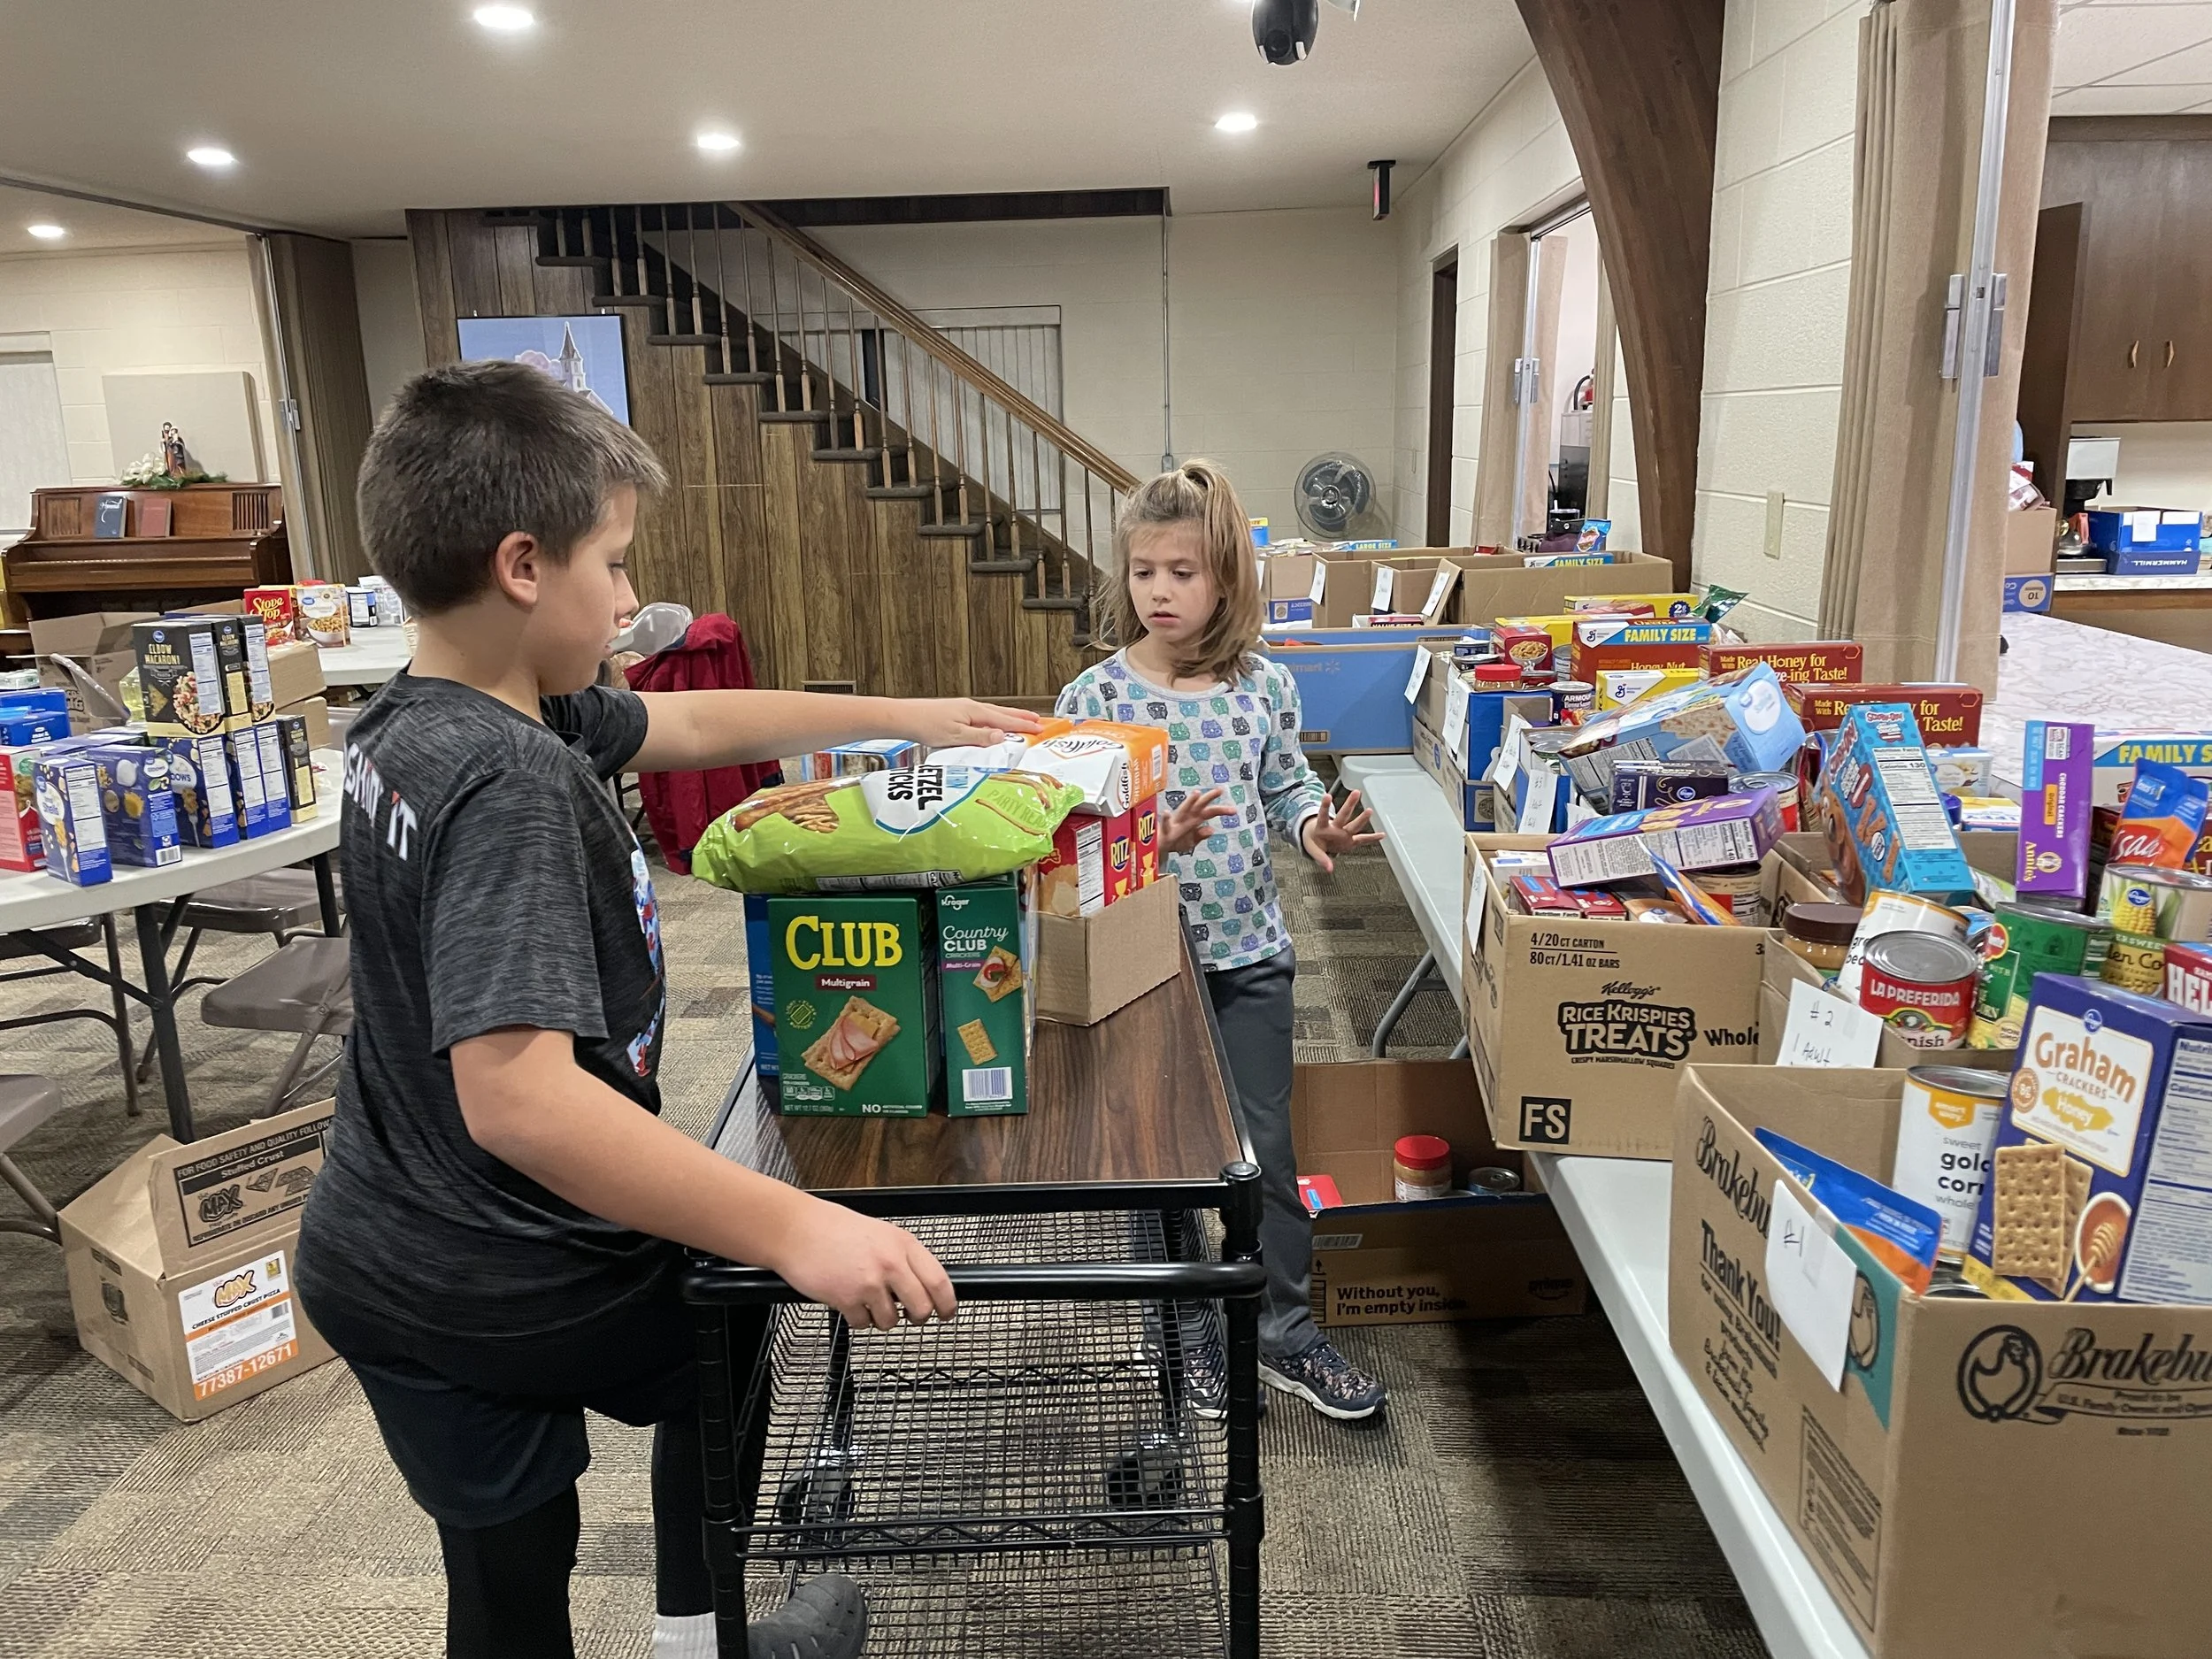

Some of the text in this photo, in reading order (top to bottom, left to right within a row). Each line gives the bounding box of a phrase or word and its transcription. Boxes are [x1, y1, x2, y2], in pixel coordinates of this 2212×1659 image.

[1555, 557, 1604, 567] FAMILY SIZE
[252, 596, 284, 611] Stove
[262, 607, 281, 621] Top
[1624, 627, 1697, 642] FAMILY SIZE
[148, 643, 173, 655] ELBOW
[144, 655, 180, 665] MACARONI
[1667, 661, 1686, 670] Nut
[1720, 652, 1826, 671] Made Real Honey for
[1775, 667, 1847, 683] ze-ing Taste!
[1815, 699, 1832, 708] Made
[1920, 698, 1940, 716] for
[1815, 707, 1832, 716] With
[1924, 717, 1963, 733] Taste!
[1042, 736, 1125, 755] Goldfish
[2118, 744, 2198, 764] FAMILY
[918, 764, 943, 810] ETZEL
[1121, 762, 1132, 810] Goldfish
[987, 787, 1021, 817] PARTY
[1138, 812, 1156, 843] RITZ
[1110, 836, 1130, 868] RITZ
[1726, 848, 1736, 861] 140
[1747, 845, 1756, 858] Facts
[2023, 841, 2038, 883] Annie's
[941, 895, 970, 910] Kroger
[785, 914, 903, 971] CLUB
[942, 925, 1009, 942] Country
[943, 939, 987, 952] CLUB
[1572, 938, 1605, 949] CARTON
[1586, 957, 1596, 967] OZ
[1598, 958, 1621, 970] BARS
[2139, 953, 2165, 971] Co
[820, 977, 871, 990] Multigrain
[1601, 980, 1655, 999] Kellogg's
[2167, 961, 2212, 1018] HEL
[1870, 979, 1886, 997] LA
[1886, 982, 1961, 1007] PREFERIDA
[1562, 1003, 1691, 1030] RICE KRISPIES
[1999, 1033, 2019, 1042] GMO
[2001, 1025, 2020, 1036] NON
[1565, 1023, 1685, 1057] TREATS
[1906, 1033, 1945, 1048] nish
[2034, 1032, 2137, 1104] Graham
[2055, 1070, 2108, 1100] CRACKERS
[862, 1103, 881, 1114] NO
[2057, 1094, 2093, 1127] Honey
[1523, 1102, 1566, 1141] FS
[178, 1119, 330, 1179] FOR FOOD SAFETY AND QUALITY FOLLOW
[1942, 1137, 1983, 1151] sweet
[221, 1150, 285, 1179] Stuffed Crust
[1694, 1114, 1771, 1240] Brakebu
[200, 1185, 243, 1223] MAX
[1934, 1194, 1977, 1210] whole
[214, 1270, 257, 1309] MAX
[1701, 1218, 1743, 1311] Thank
[1746, 1277, 1781, 1349] You!
[1336, 1286, 1440, 1303] Without you,
[192, 1316, 217, 1330] CHEESE
[216, 1305, 242, 1322] STUFFED
[243, 1295, 263, 1309] CRUST
[263, 1288, 281, 1300] PIZZA
[1337, 1302, 1416, 1317] I'm empty
[2047, 1326, 2212, 1386] Brakebu
[199, 1342, 292, 1397] 77387-12671
